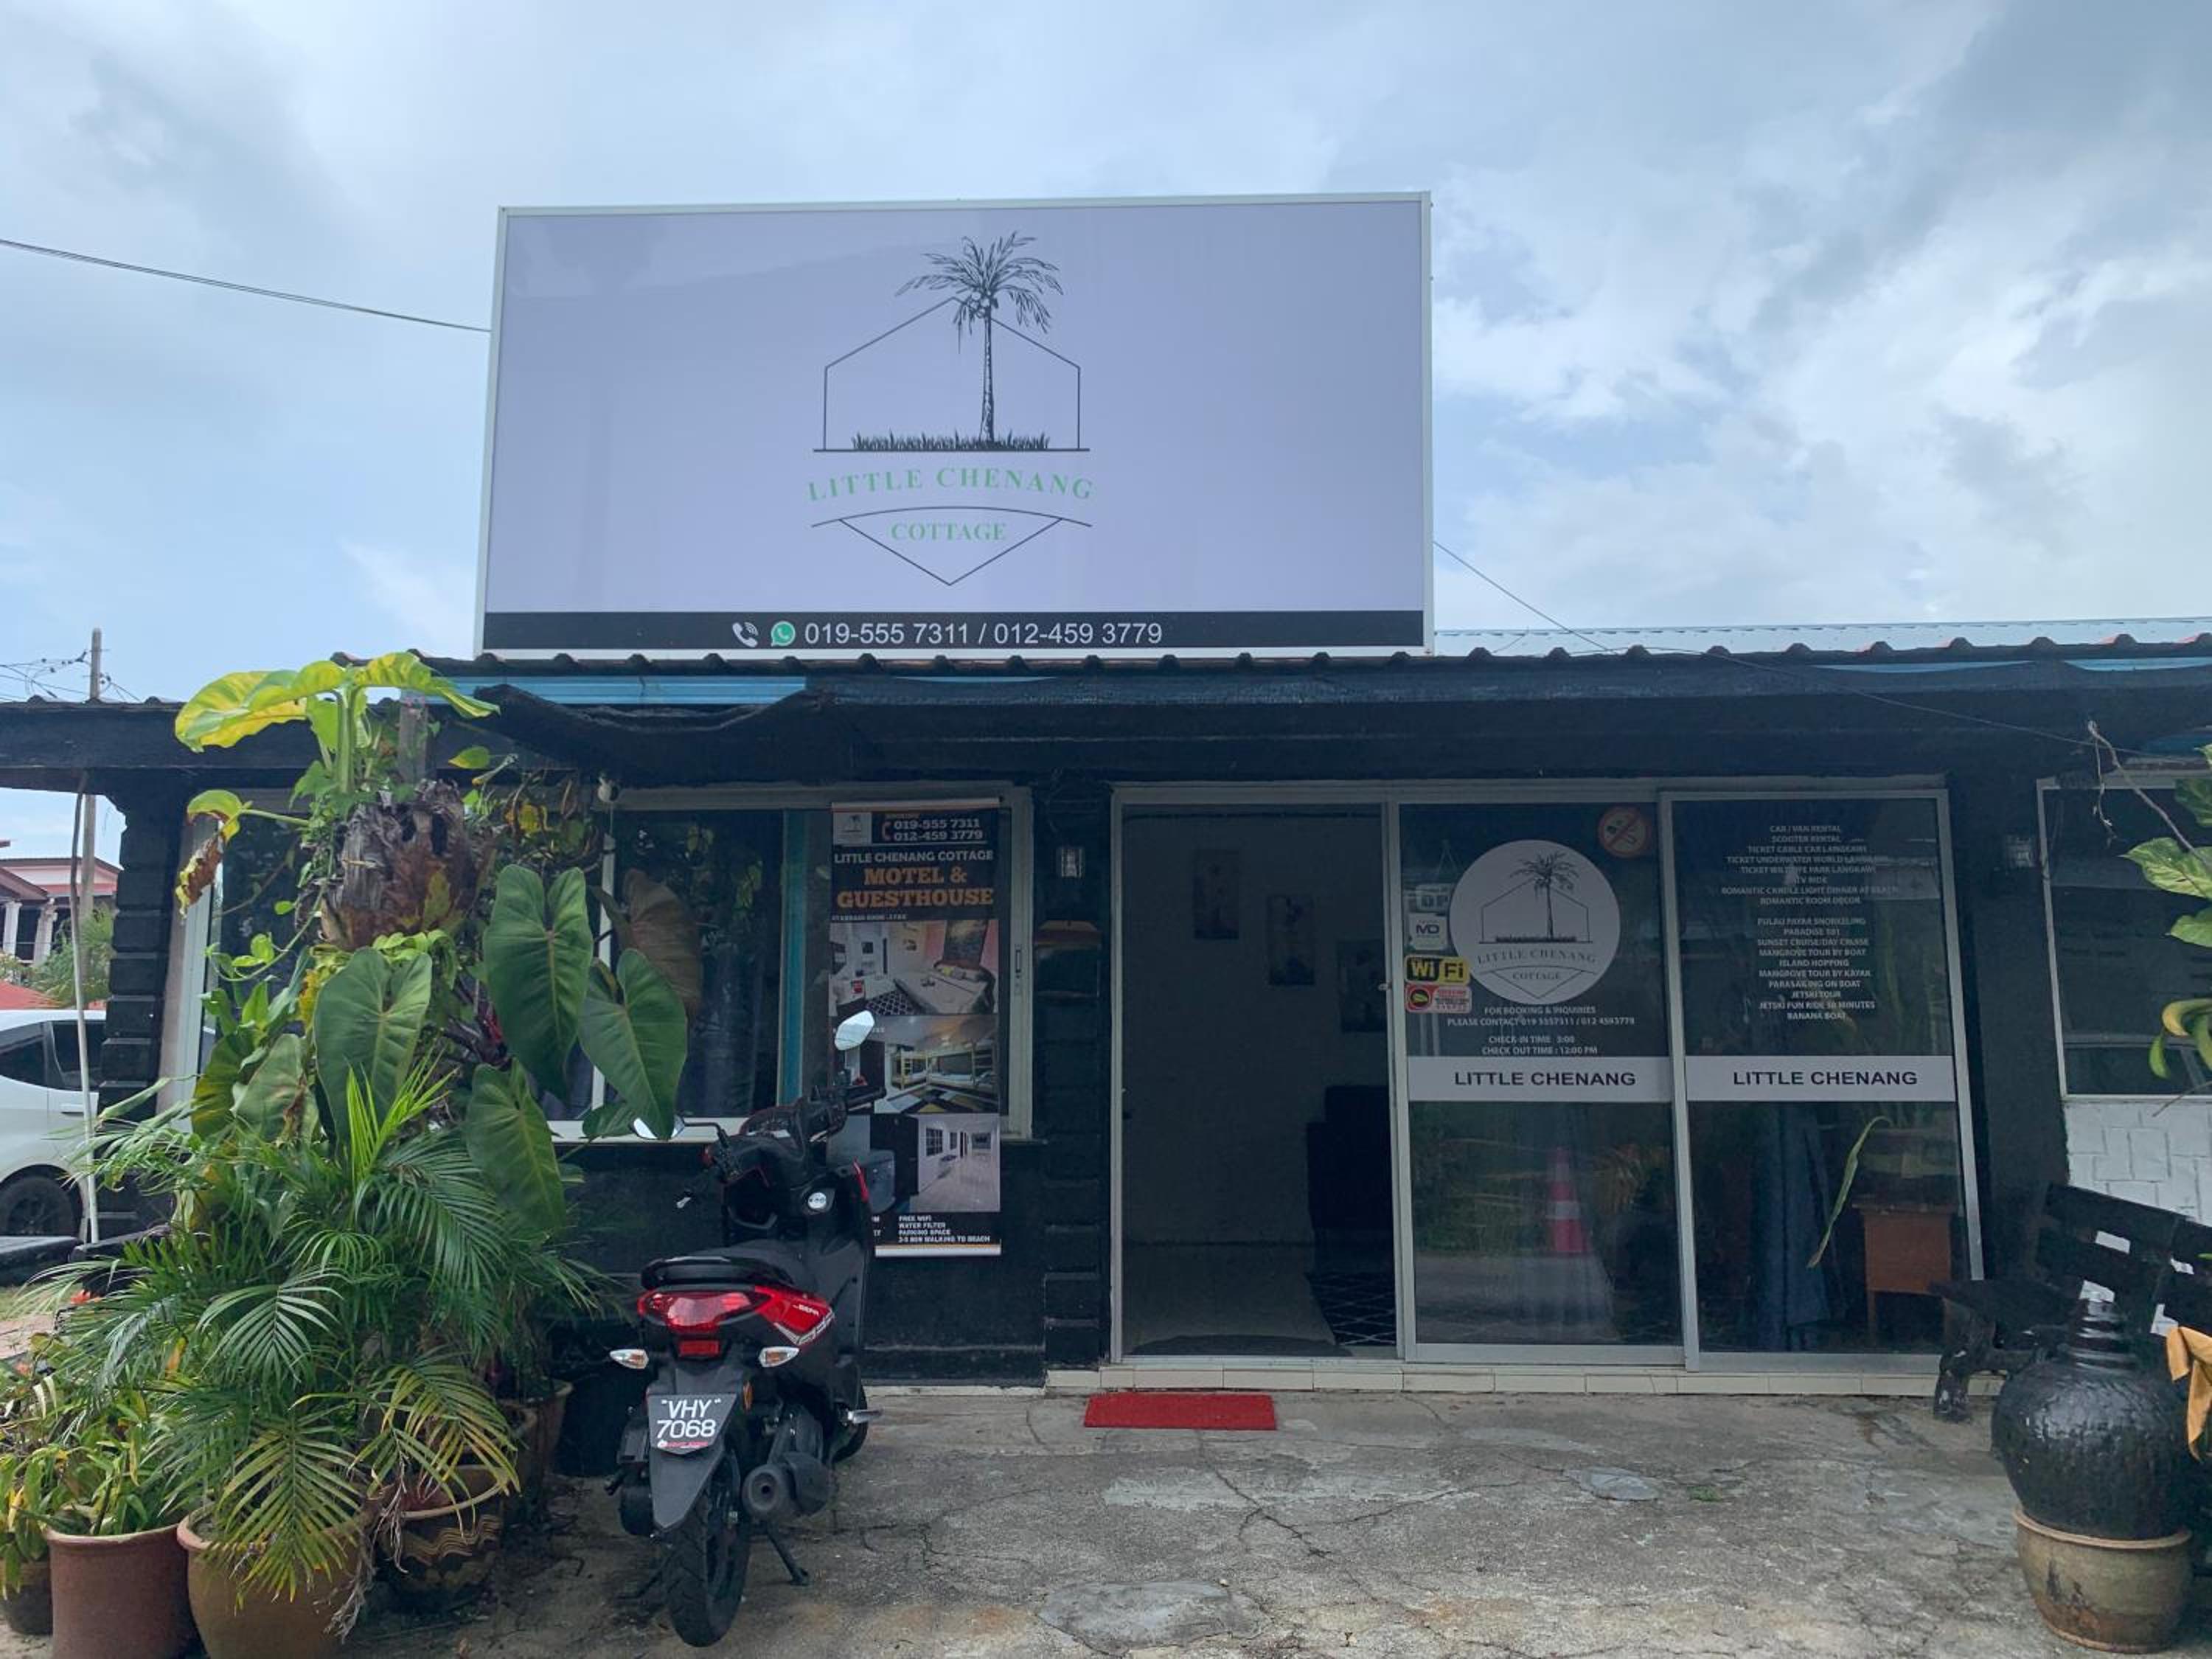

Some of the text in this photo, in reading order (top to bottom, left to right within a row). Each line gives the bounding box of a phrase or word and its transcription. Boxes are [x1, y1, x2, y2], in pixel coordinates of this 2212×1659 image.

[808, 467, 1094, 501] LITTLE CHENANG
[890, 523, 1006, 540] COTTAGE
[804, 624, 905, 645] 019-555
[913, 624, 967, 644] 7311
[994, 623, 1093, 644] 012-459
[1102, 623, 1162, 644] 3779
[894, 818, 980, 830] 019-555 7311
[894, 830, 984, 841] 012-459 3779
[834, 850, 994, 863] LITTLE CHENANG COTTAGE
[863, 866, 967, 885] MOTEL &
[837, 888, 994, 908] GUESTHOUSE
[1477, 949, 1596, 964] LITTLE CHENANG
[1512, 971, 1560, 980] COTTAGE
[1838, 980, 1861, 988] BOAT
[1447, 1018, 1478, 1026] PLEASE
[1482, 1046, 1511, 1054] CHECK
[1512, 1046, 1531, 1054] OUT
[1455, 1072, 1636, 1085] LITTLE CHENANG
[1733, 1071, 1919, 1085] LITTLE CHENANG
[668, 1399, 712, 1419] VHY
[657, 1419, 717, 1439] 7068
